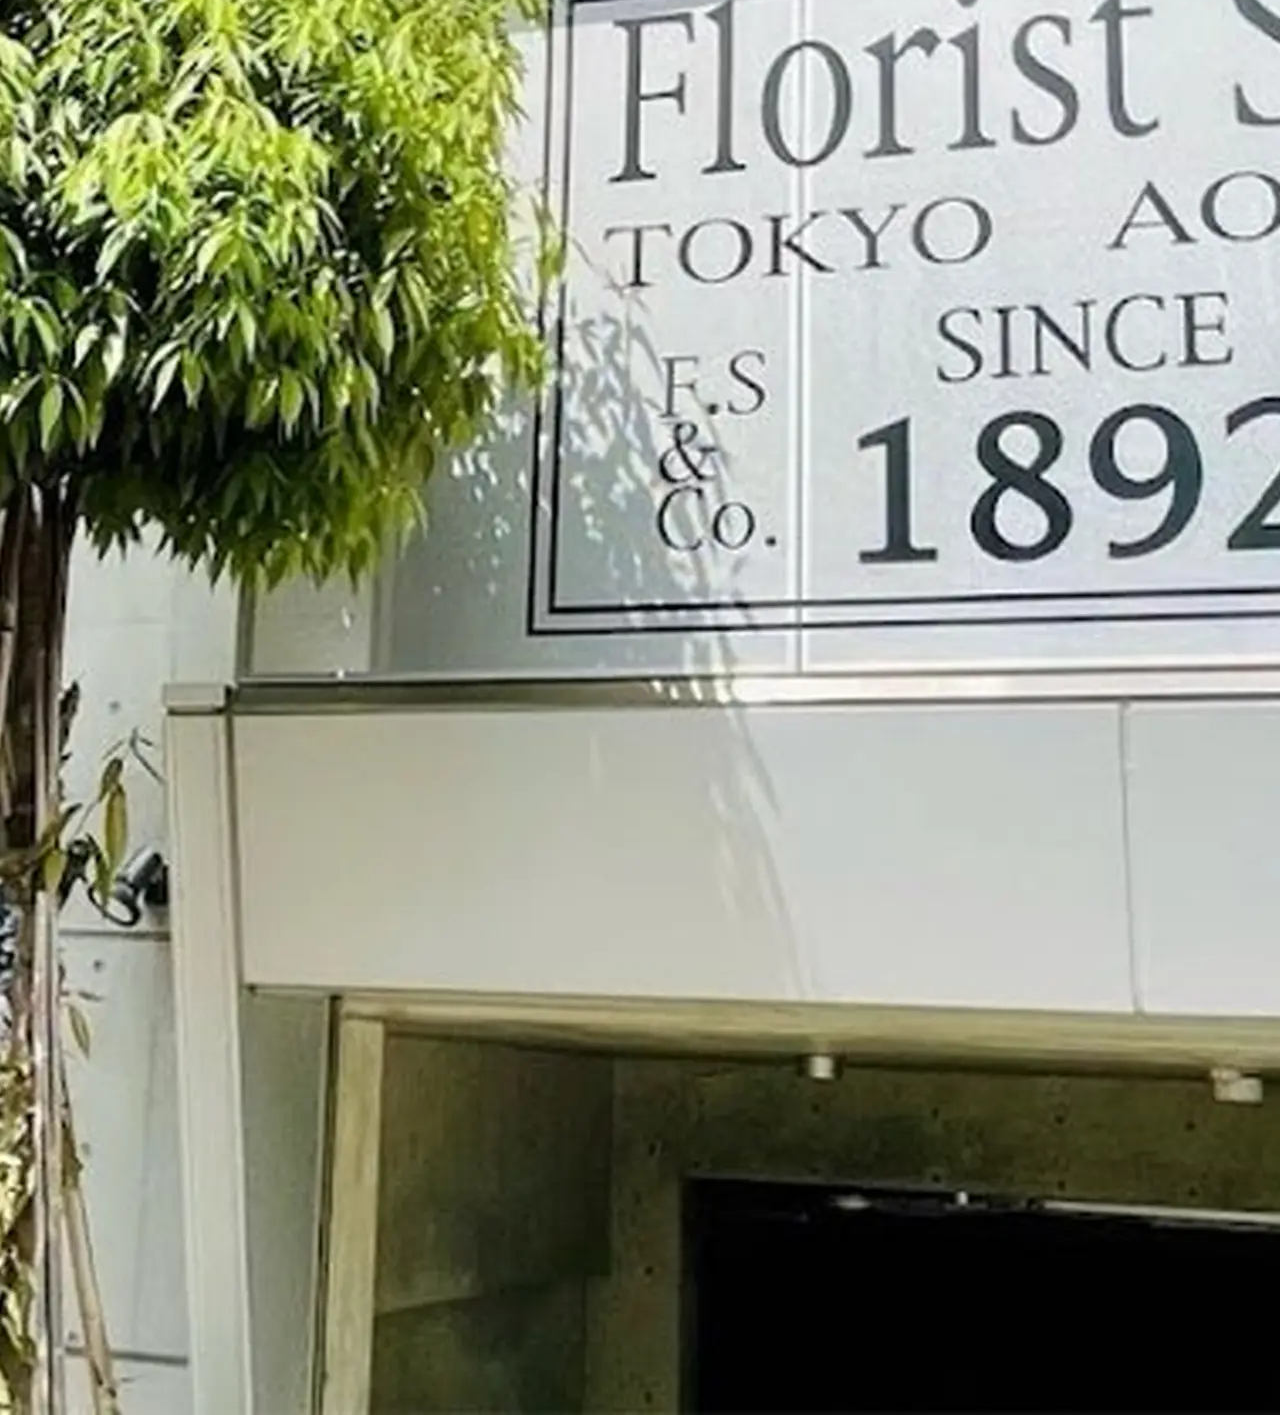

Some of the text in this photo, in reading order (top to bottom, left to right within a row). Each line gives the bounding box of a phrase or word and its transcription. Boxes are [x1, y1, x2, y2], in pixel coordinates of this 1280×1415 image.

[604, 196, 993, 288] TOKYO
[937, 291, 1234, 384] SINCE
[659, 349, 767, 420] F.S
[658, 421, 718, 484] &
[656, 486, 778, 551] Co.
